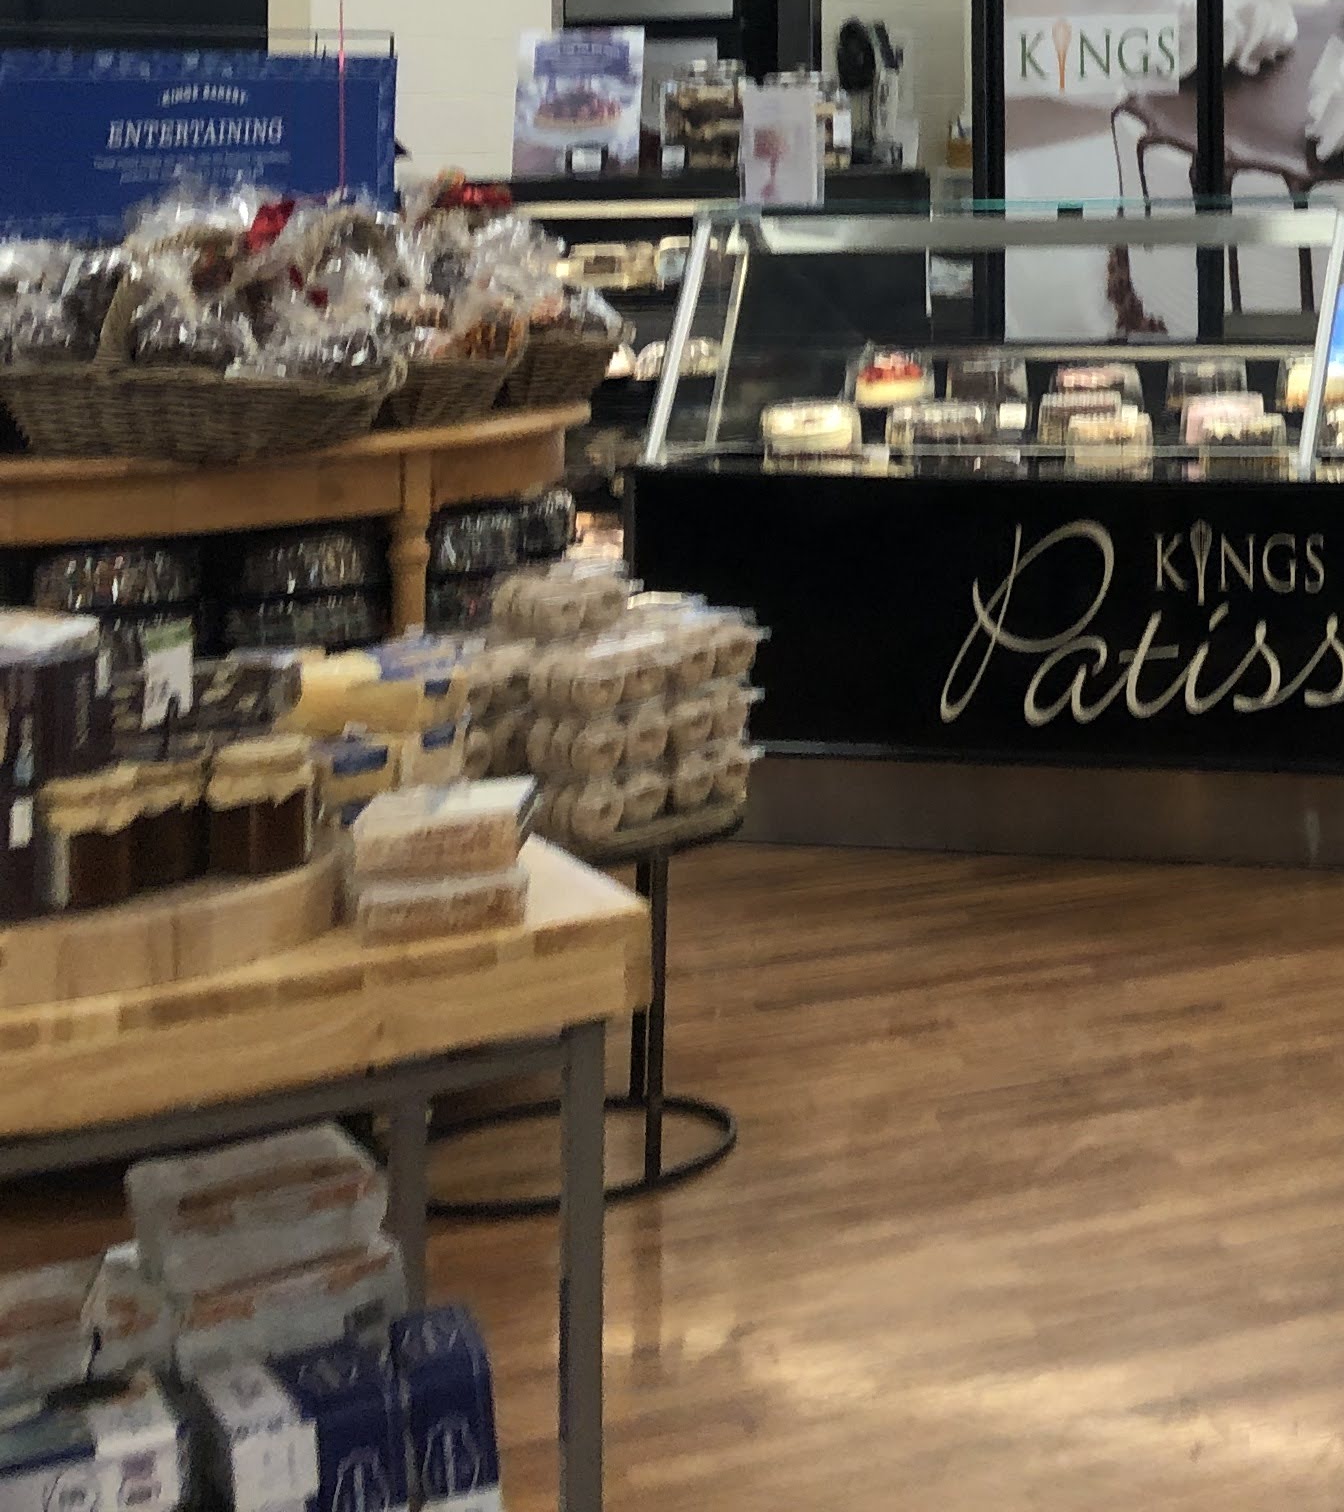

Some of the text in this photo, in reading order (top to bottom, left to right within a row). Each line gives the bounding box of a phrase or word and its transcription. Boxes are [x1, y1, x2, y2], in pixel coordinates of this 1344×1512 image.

[1019, 18, 1176, 95] KINGS
[107, 117, 283, 150] ENTERTAINING
[1154, 519, 1326, 606] KINGS
